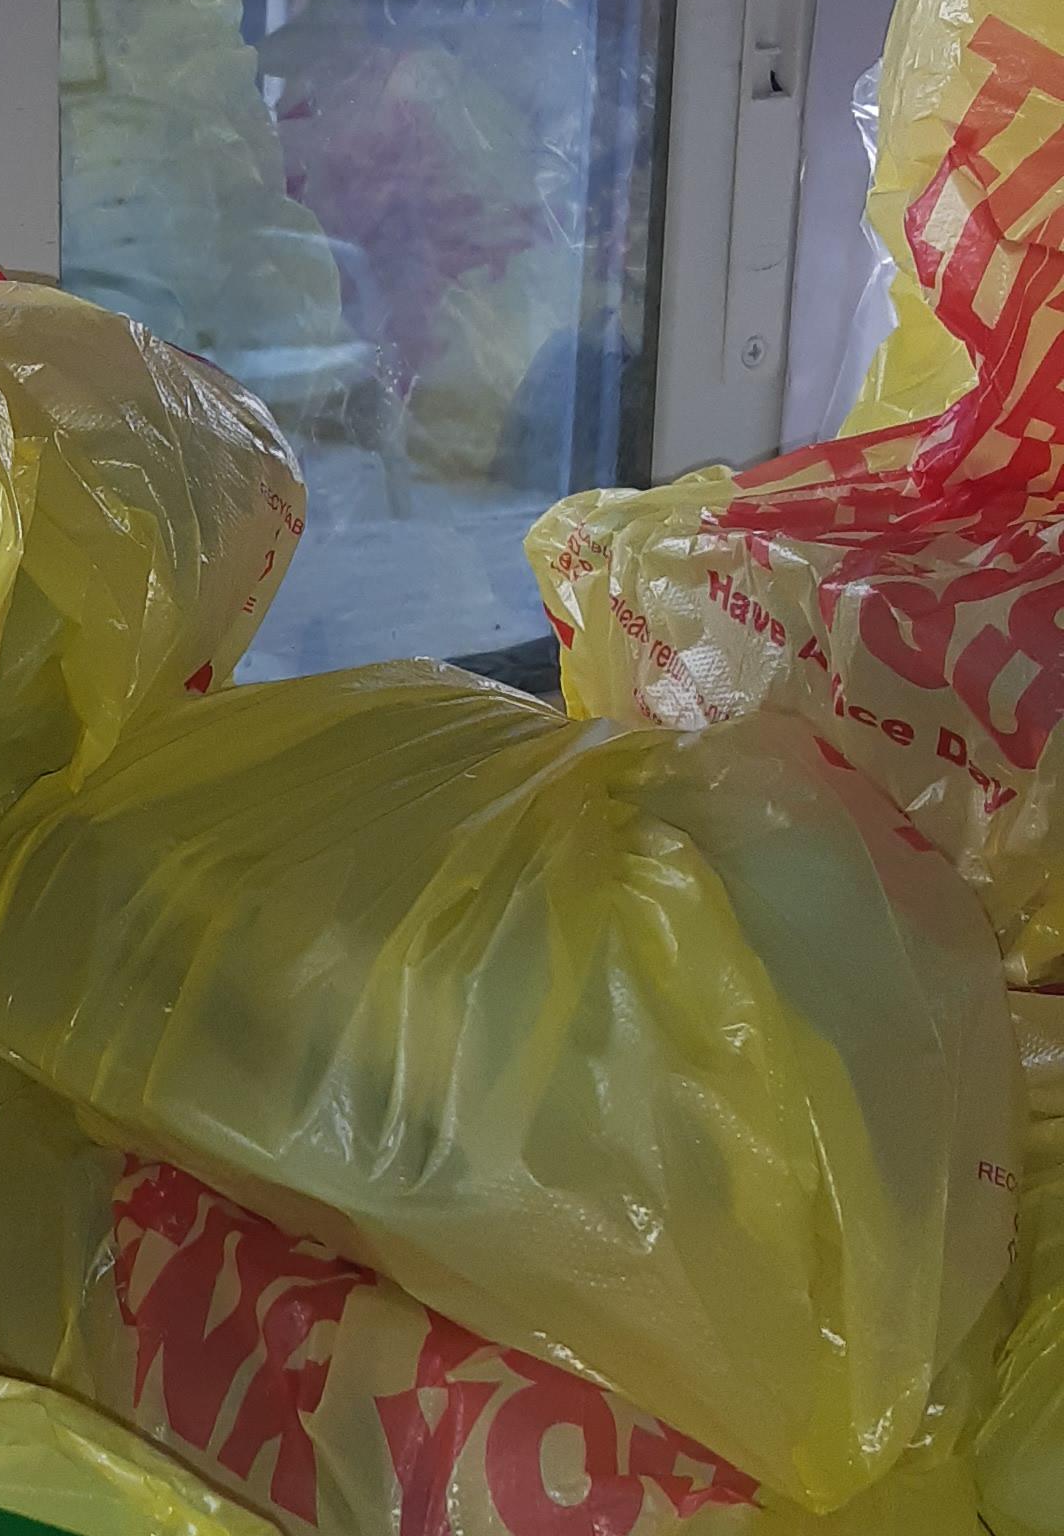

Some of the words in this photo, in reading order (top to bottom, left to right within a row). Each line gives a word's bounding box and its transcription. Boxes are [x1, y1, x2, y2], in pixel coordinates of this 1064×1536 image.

[707, 569, 785, 647] Have
[798, 635, 829, 673] A
[937, 726, 1018, 814] Day
